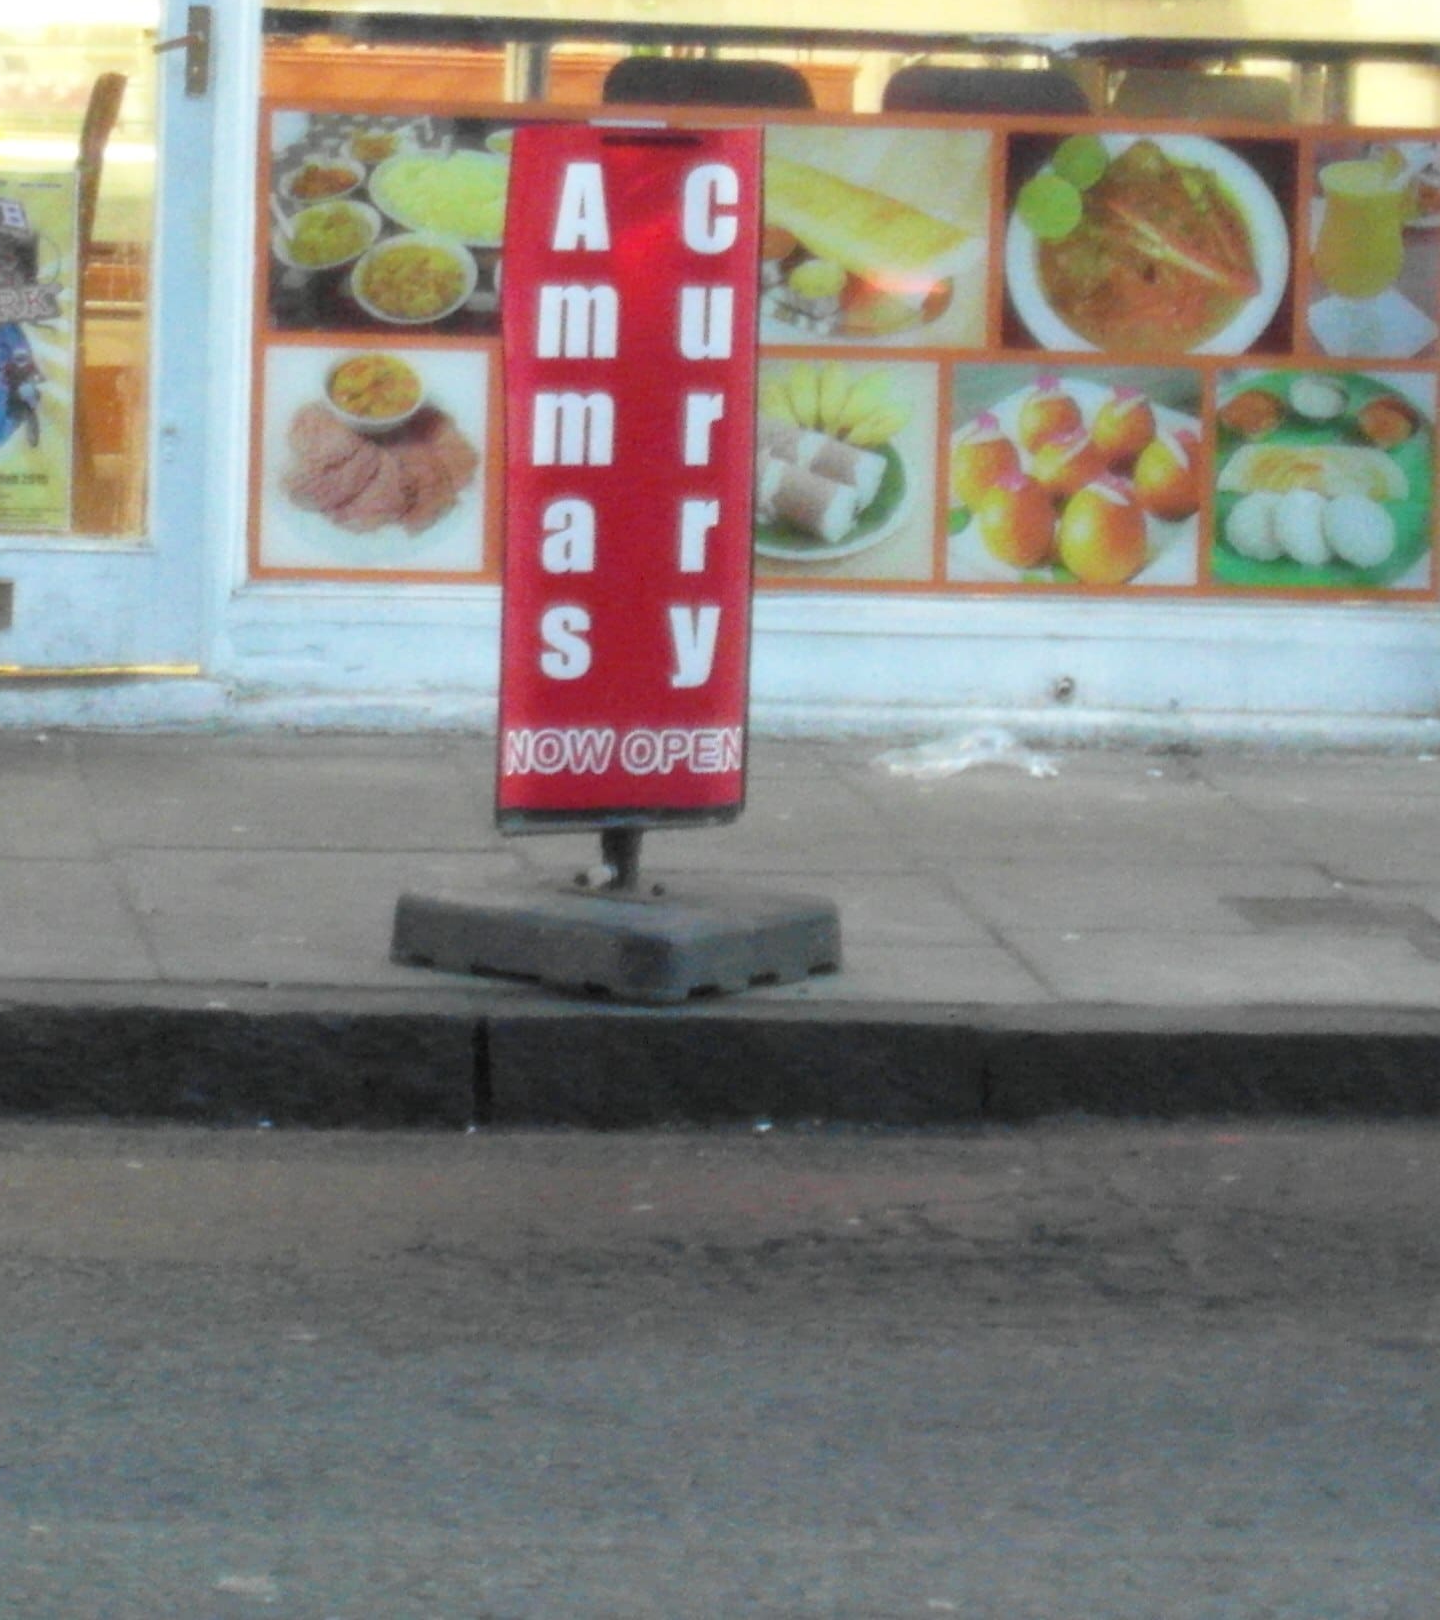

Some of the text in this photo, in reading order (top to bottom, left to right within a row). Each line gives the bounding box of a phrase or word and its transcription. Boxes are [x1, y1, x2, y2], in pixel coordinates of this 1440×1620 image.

[531, 161, 619, 680] Ammas
[668, 162, 741, 688] Curry
[505, 727, 743, 775] NOW OPEN
